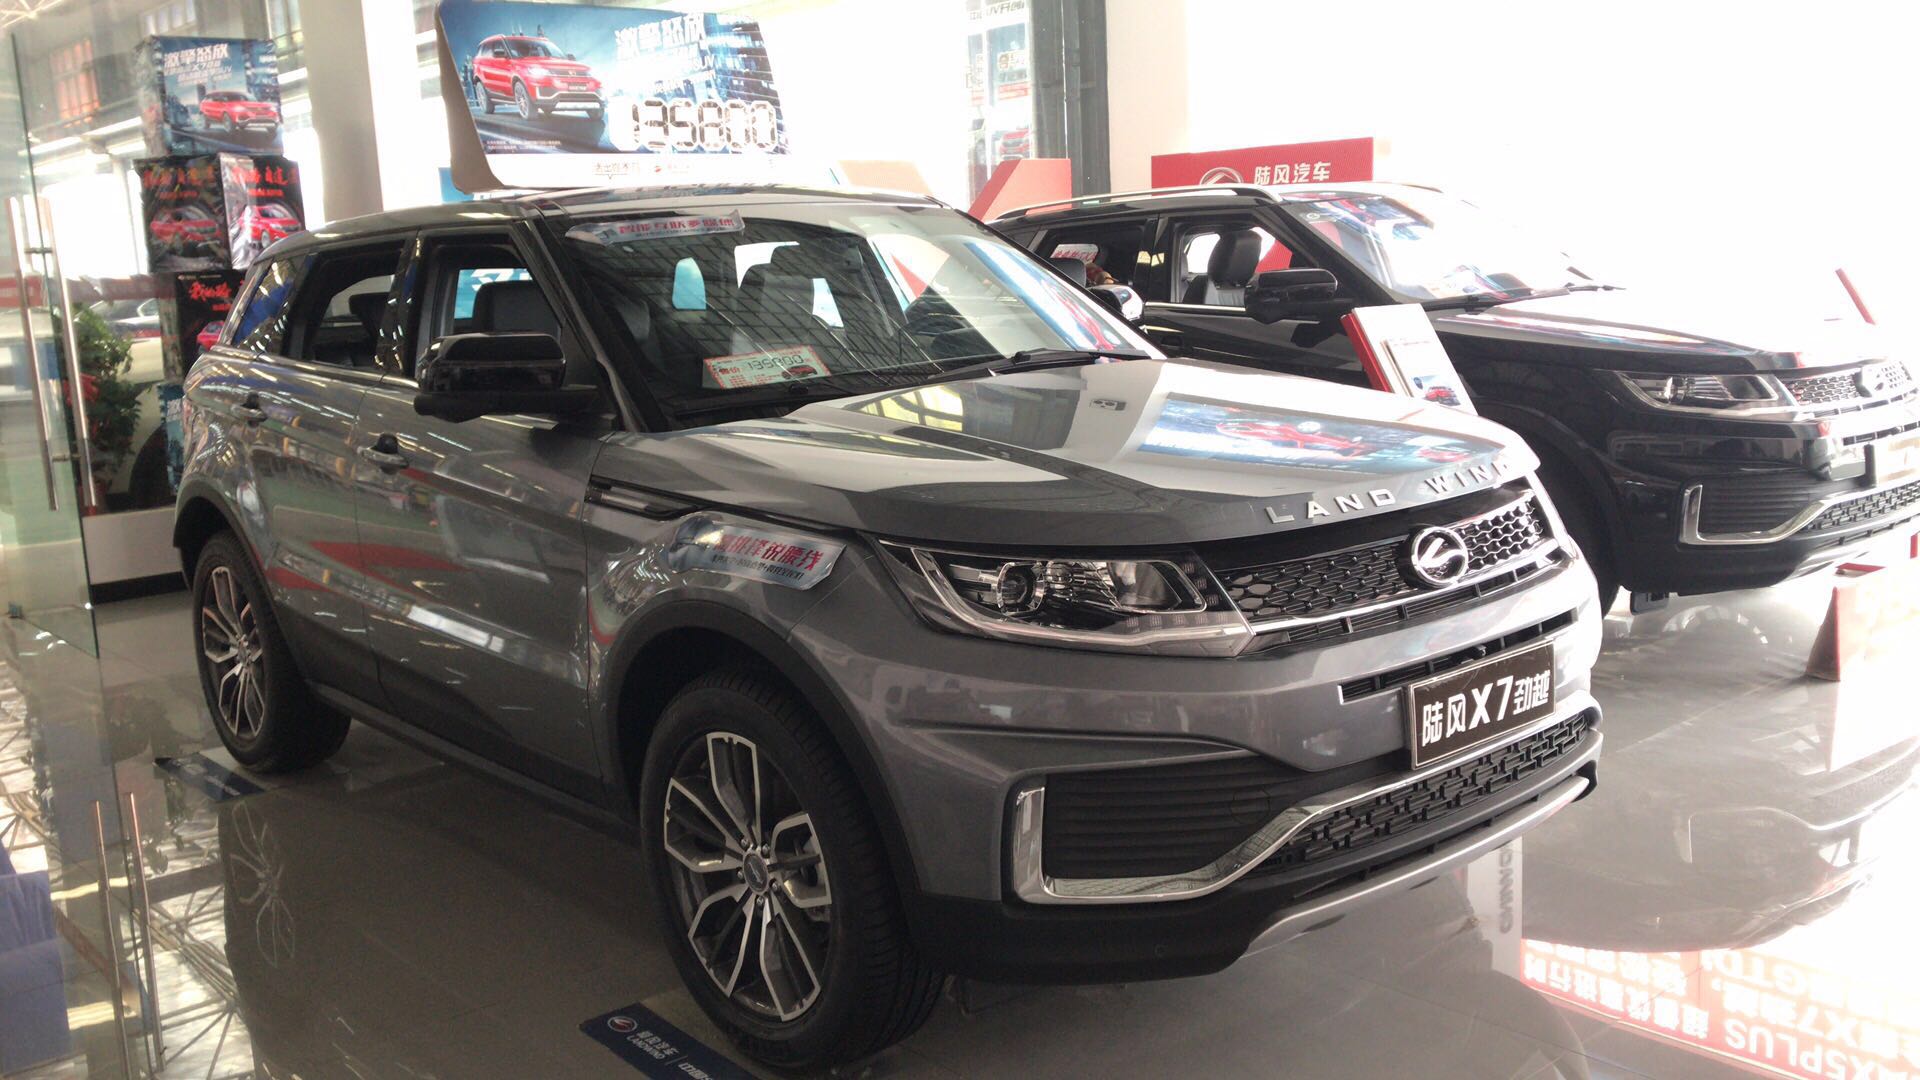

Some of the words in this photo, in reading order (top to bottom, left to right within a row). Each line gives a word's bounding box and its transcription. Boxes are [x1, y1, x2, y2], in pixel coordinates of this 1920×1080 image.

[1254, 161, 1331, 186] 陆风汽车
[1265, 488, 1396, 524] LAND
[1422, 669, 1551, 747] 陆风X7劲越
